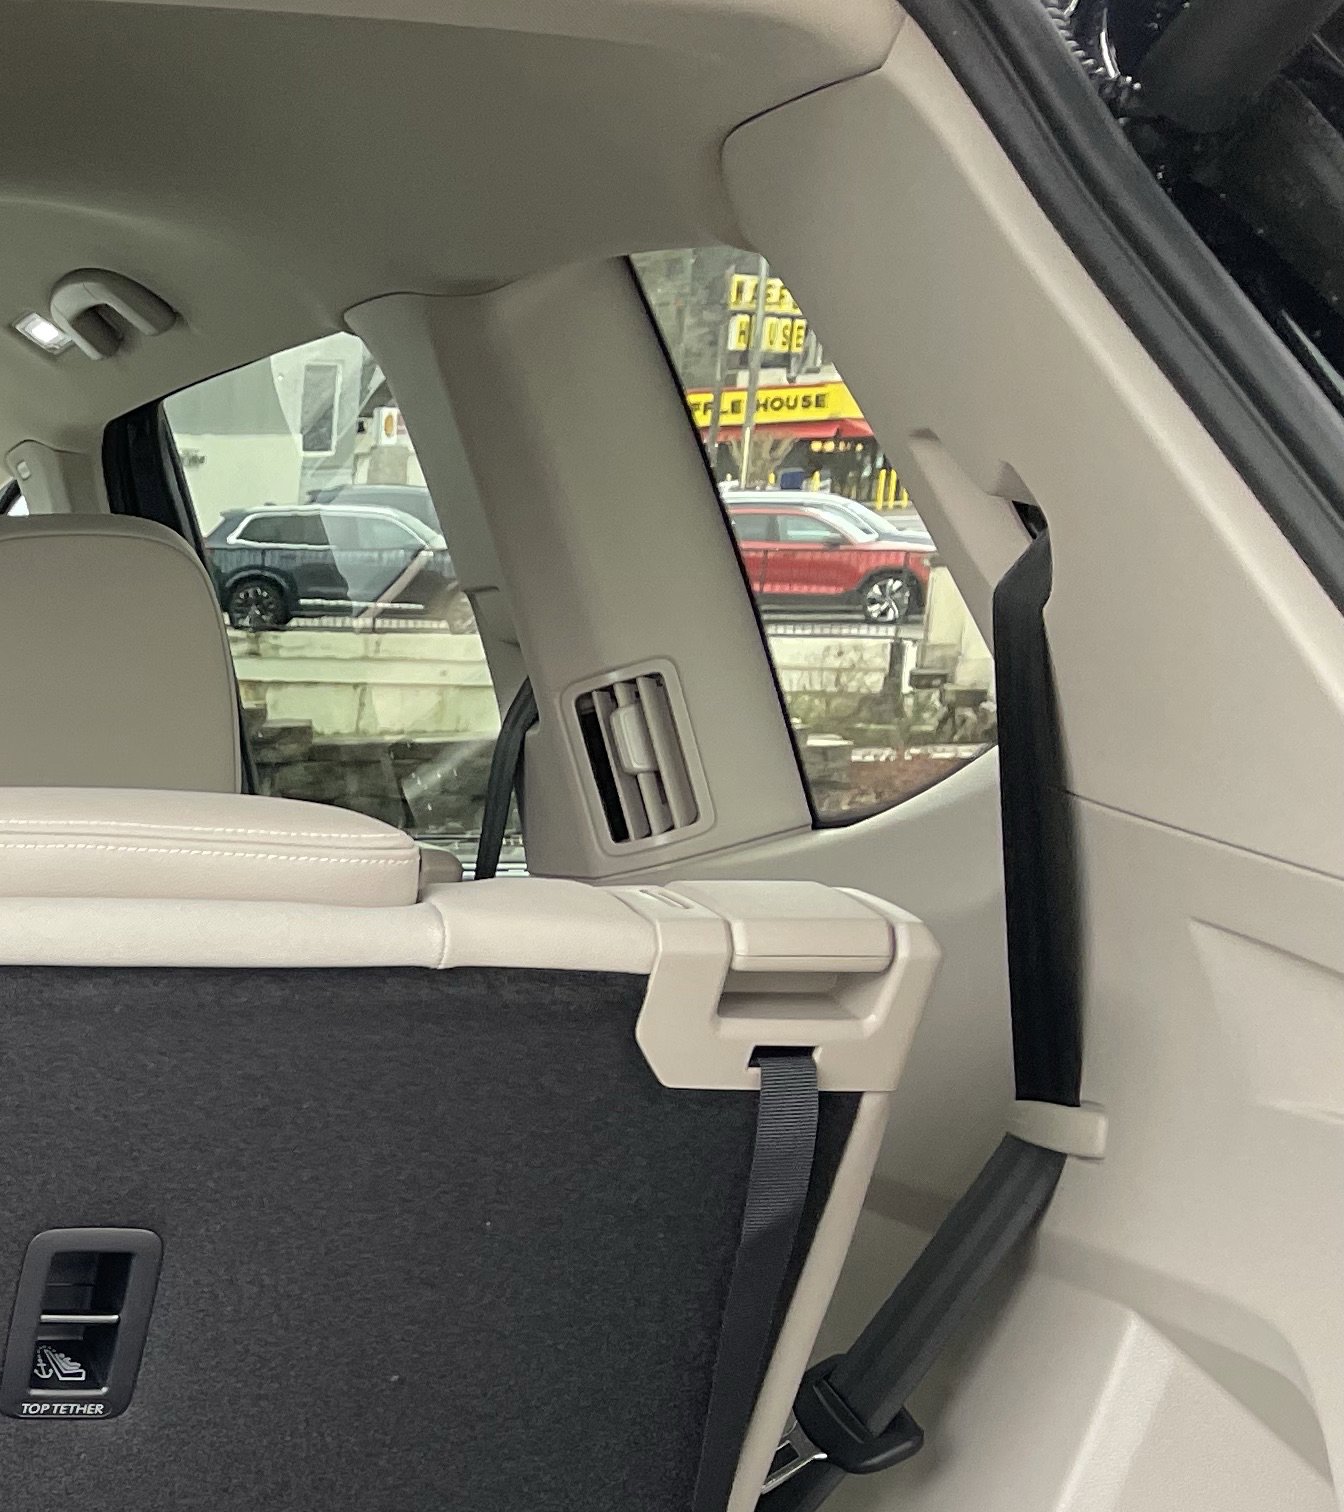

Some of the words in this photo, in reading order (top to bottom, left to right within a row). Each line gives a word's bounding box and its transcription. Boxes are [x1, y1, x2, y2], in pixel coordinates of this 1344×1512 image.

[736, 320, 804, 348] HUSE
[756, 393, 827, 412] HOUSE
[21, 1403, 50, 1414] TOP
[52, 1403, 104, 1414] TETHER
